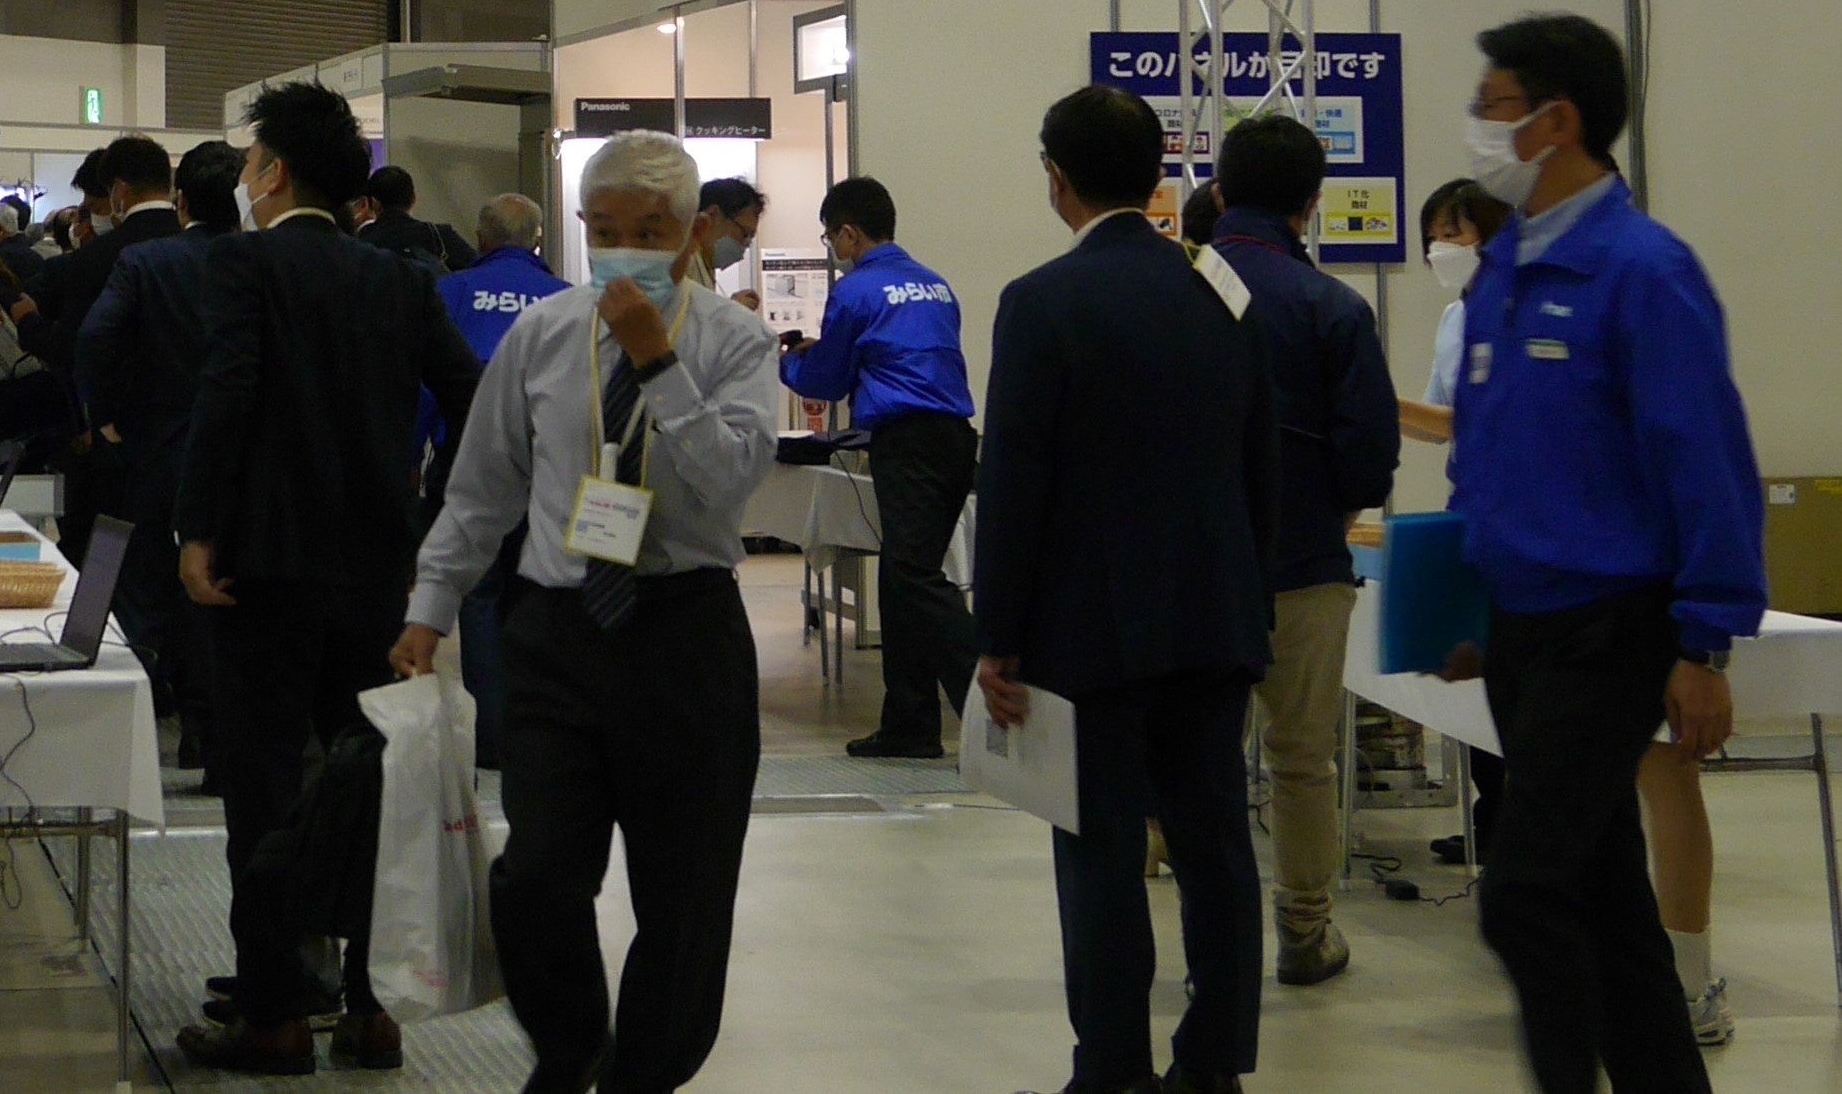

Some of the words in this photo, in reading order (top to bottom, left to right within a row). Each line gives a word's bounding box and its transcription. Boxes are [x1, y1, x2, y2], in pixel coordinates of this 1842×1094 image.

[1109, 51, 1385, 79] このルが目印です
[580, 101, 630, 111] Panasonic
[882, 281, 953, 305] みらい市
